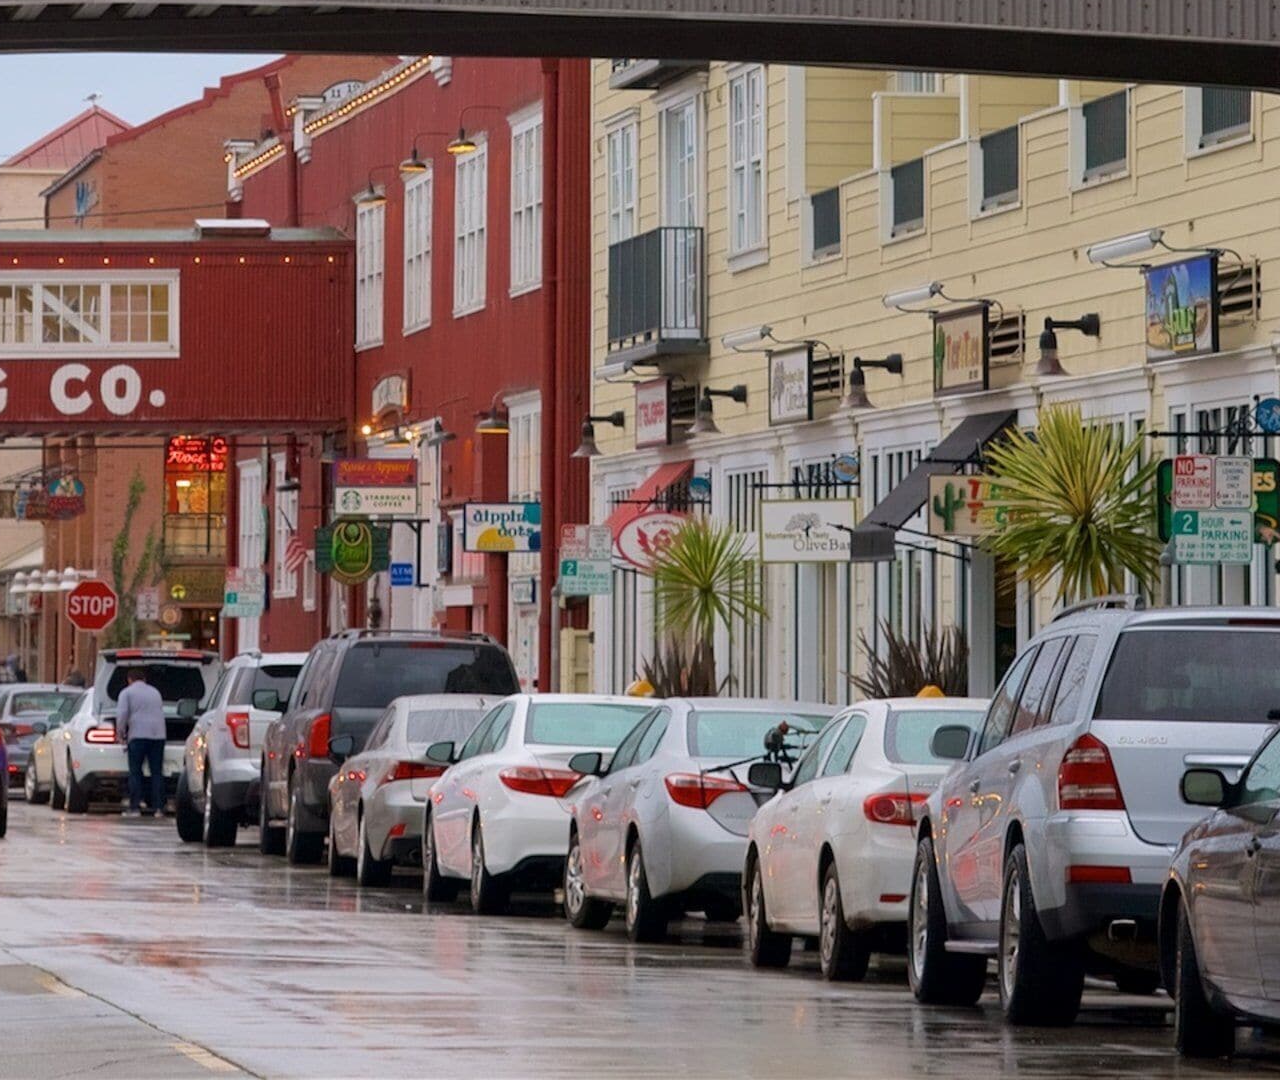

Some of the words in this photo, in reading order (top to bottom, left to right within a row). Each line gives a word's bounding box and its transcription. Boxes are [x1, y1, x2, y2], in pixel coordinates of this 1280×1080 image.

[49, 363, 167, 415] CO.
[1176, 460, 1194, 474] NO
[1176, 478, 1210, 488] PARKING
[1182, 514, 1193, 532] 2
[1201, 517, 1225, 527] HOUR
[1201, 530, 1248, 540] PARKING
[792, 538, 827, 551] Olive
[392, 568, 412, 576] ATM
[566, 562, 574, 574] 2
[70, 595, 115, 616] STOP
